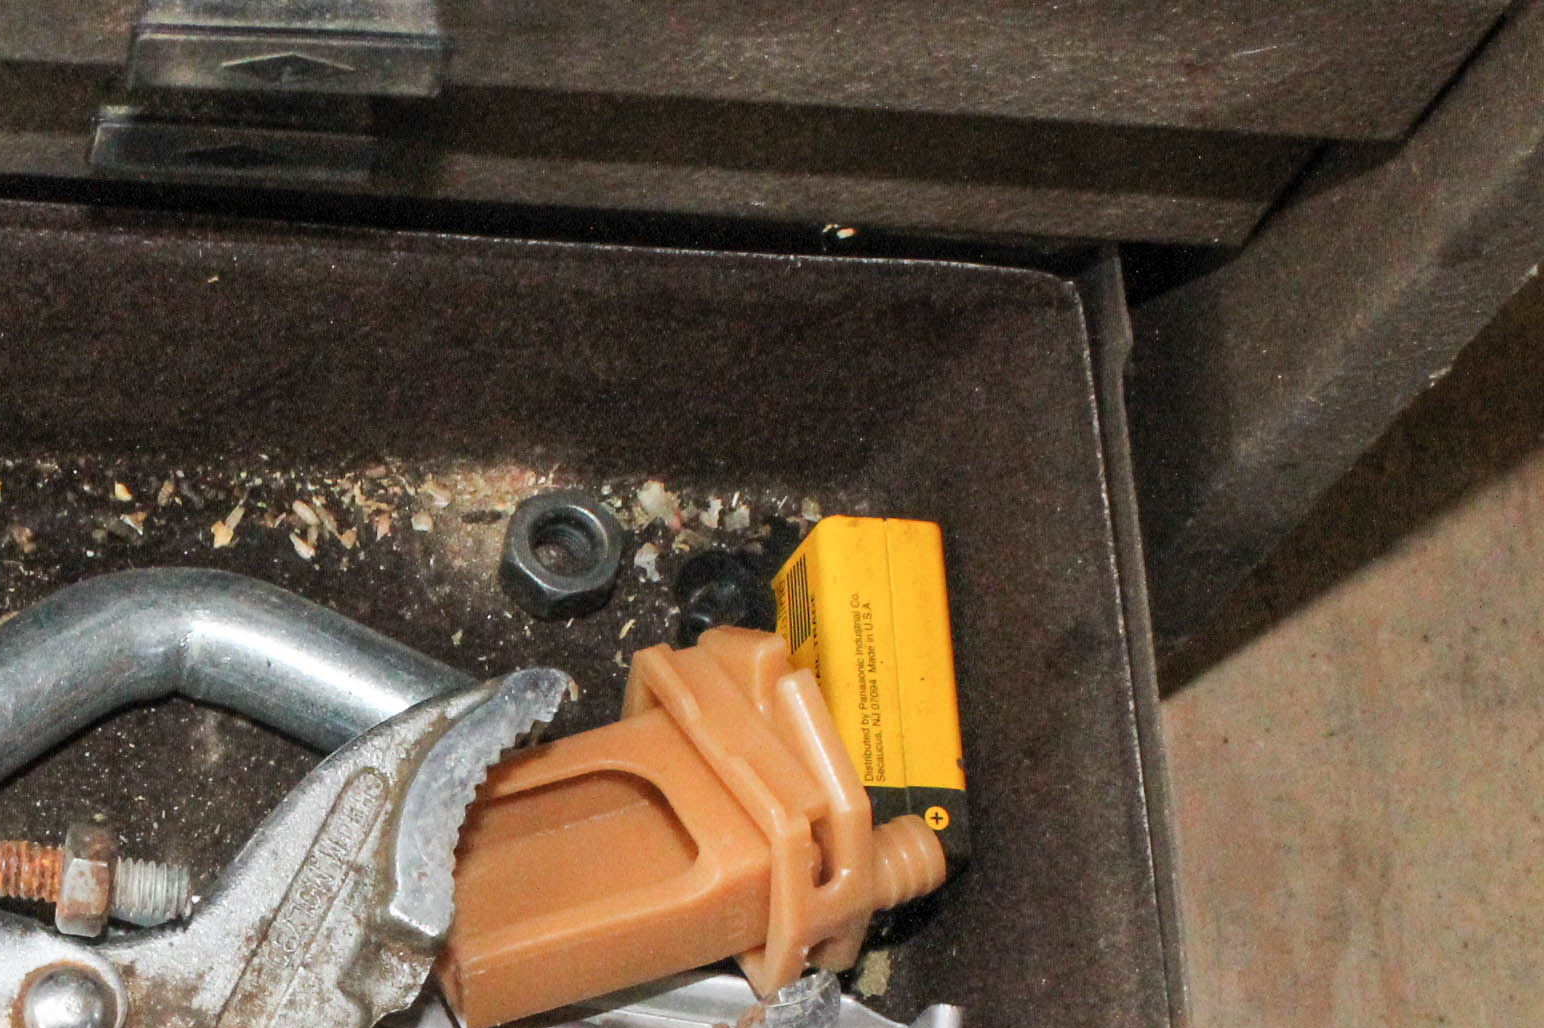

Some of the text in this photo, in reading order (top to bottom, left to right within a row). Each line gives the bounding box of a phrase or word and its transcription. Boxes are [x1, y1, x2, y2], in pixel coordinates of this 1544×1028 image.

[866, 633, 873, 643] in
[868, 646, 876, 672] Made
[849, 591, 874, 781] Distributed by Panasonic Industrial Co.
[868, 679, 880, 710] 07094
[871, 712, 881, 727] NJ
